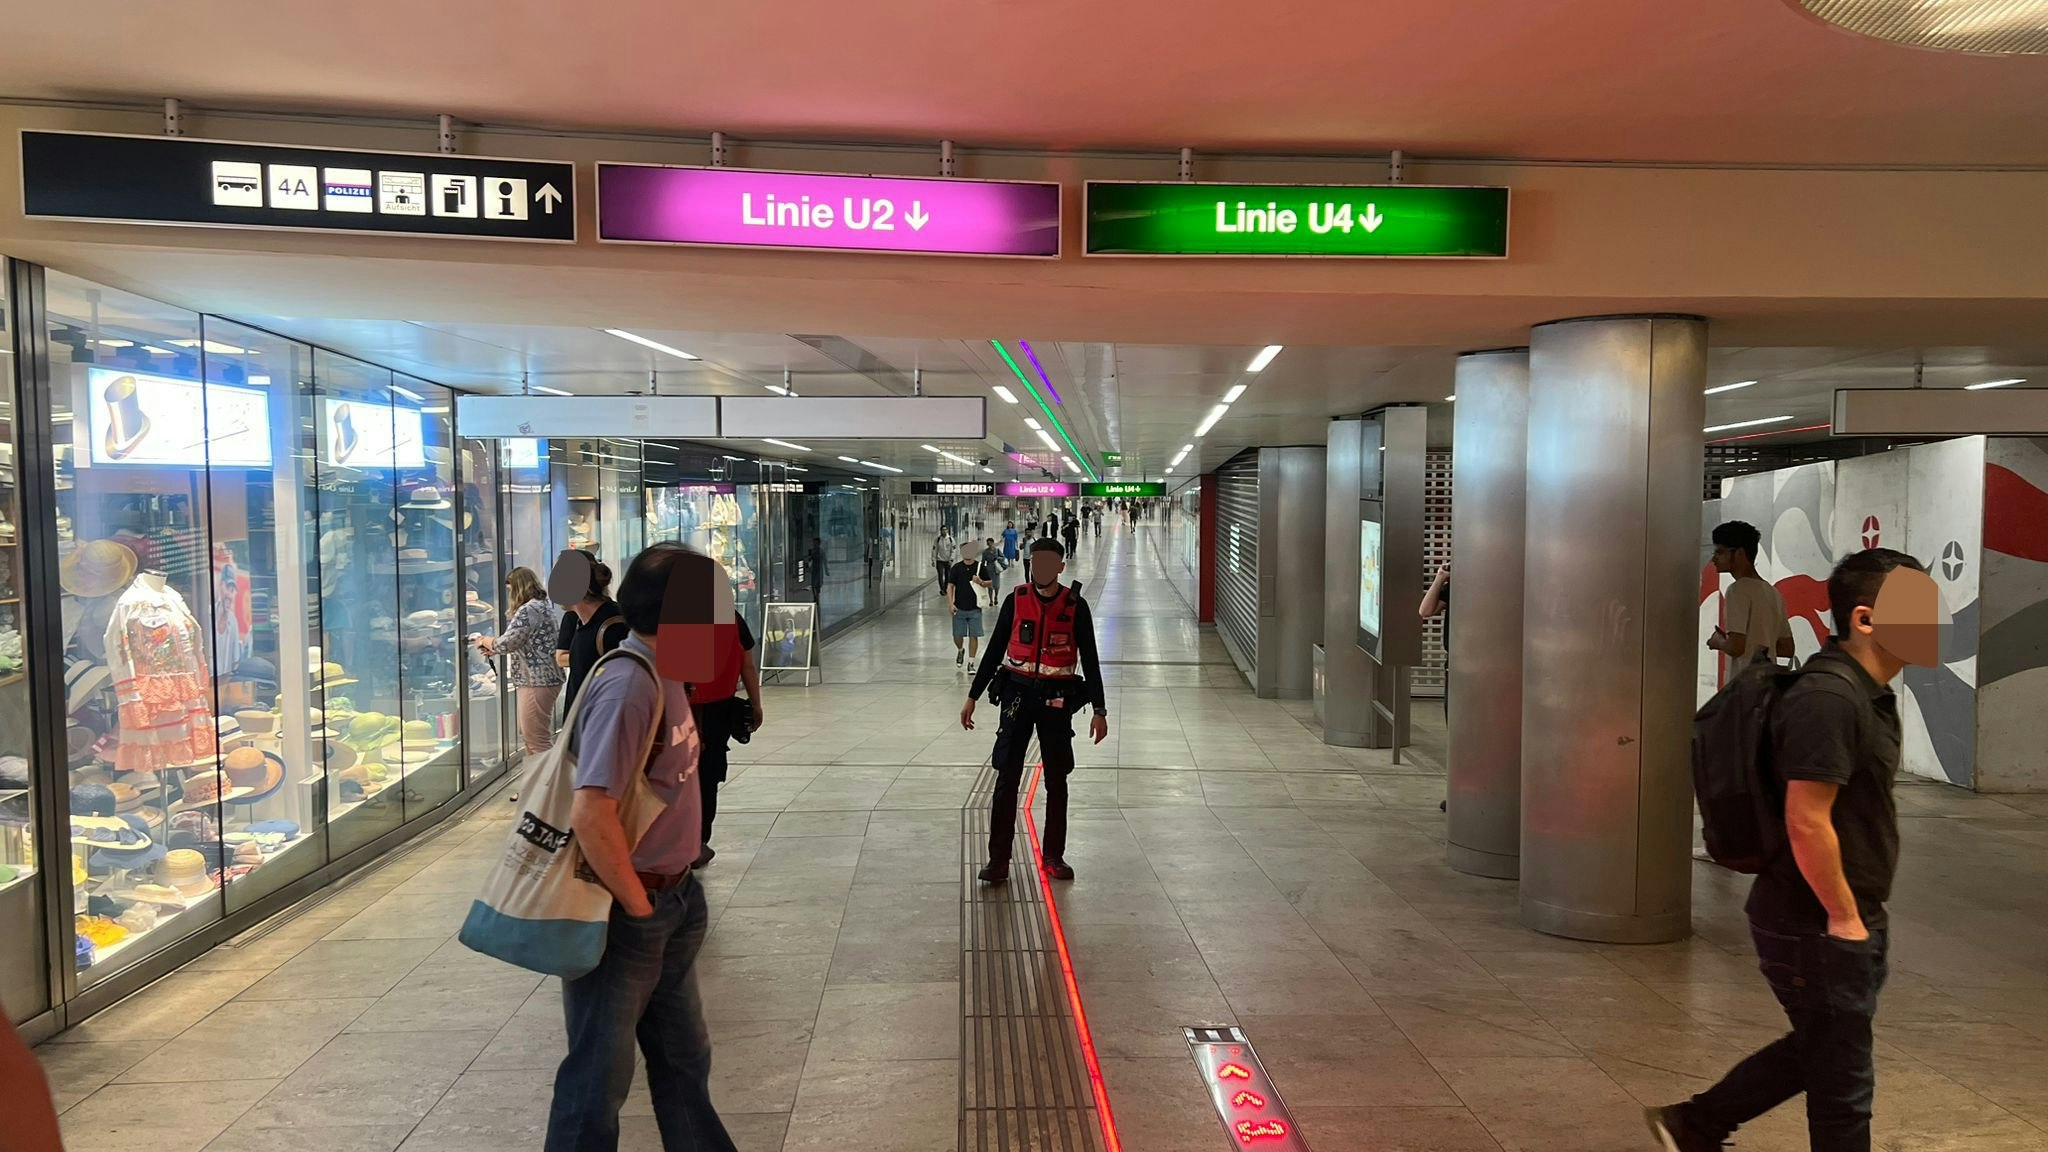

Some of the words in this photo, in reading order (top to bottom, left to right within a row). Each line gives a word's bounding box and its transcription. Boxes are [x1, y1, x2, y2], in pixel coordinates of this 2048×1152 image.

[278, 178, 310, 197] 4A
[328, 187, 370, 197] POLIZEI
[385, 203, 420, 212] Aufsicht
[742, 192, 835, 228] Linie
[843, 197, 895, 231] U2
[1215, 201, 1298, 233] Linie
[1308, 202, 1354, 233] U4
